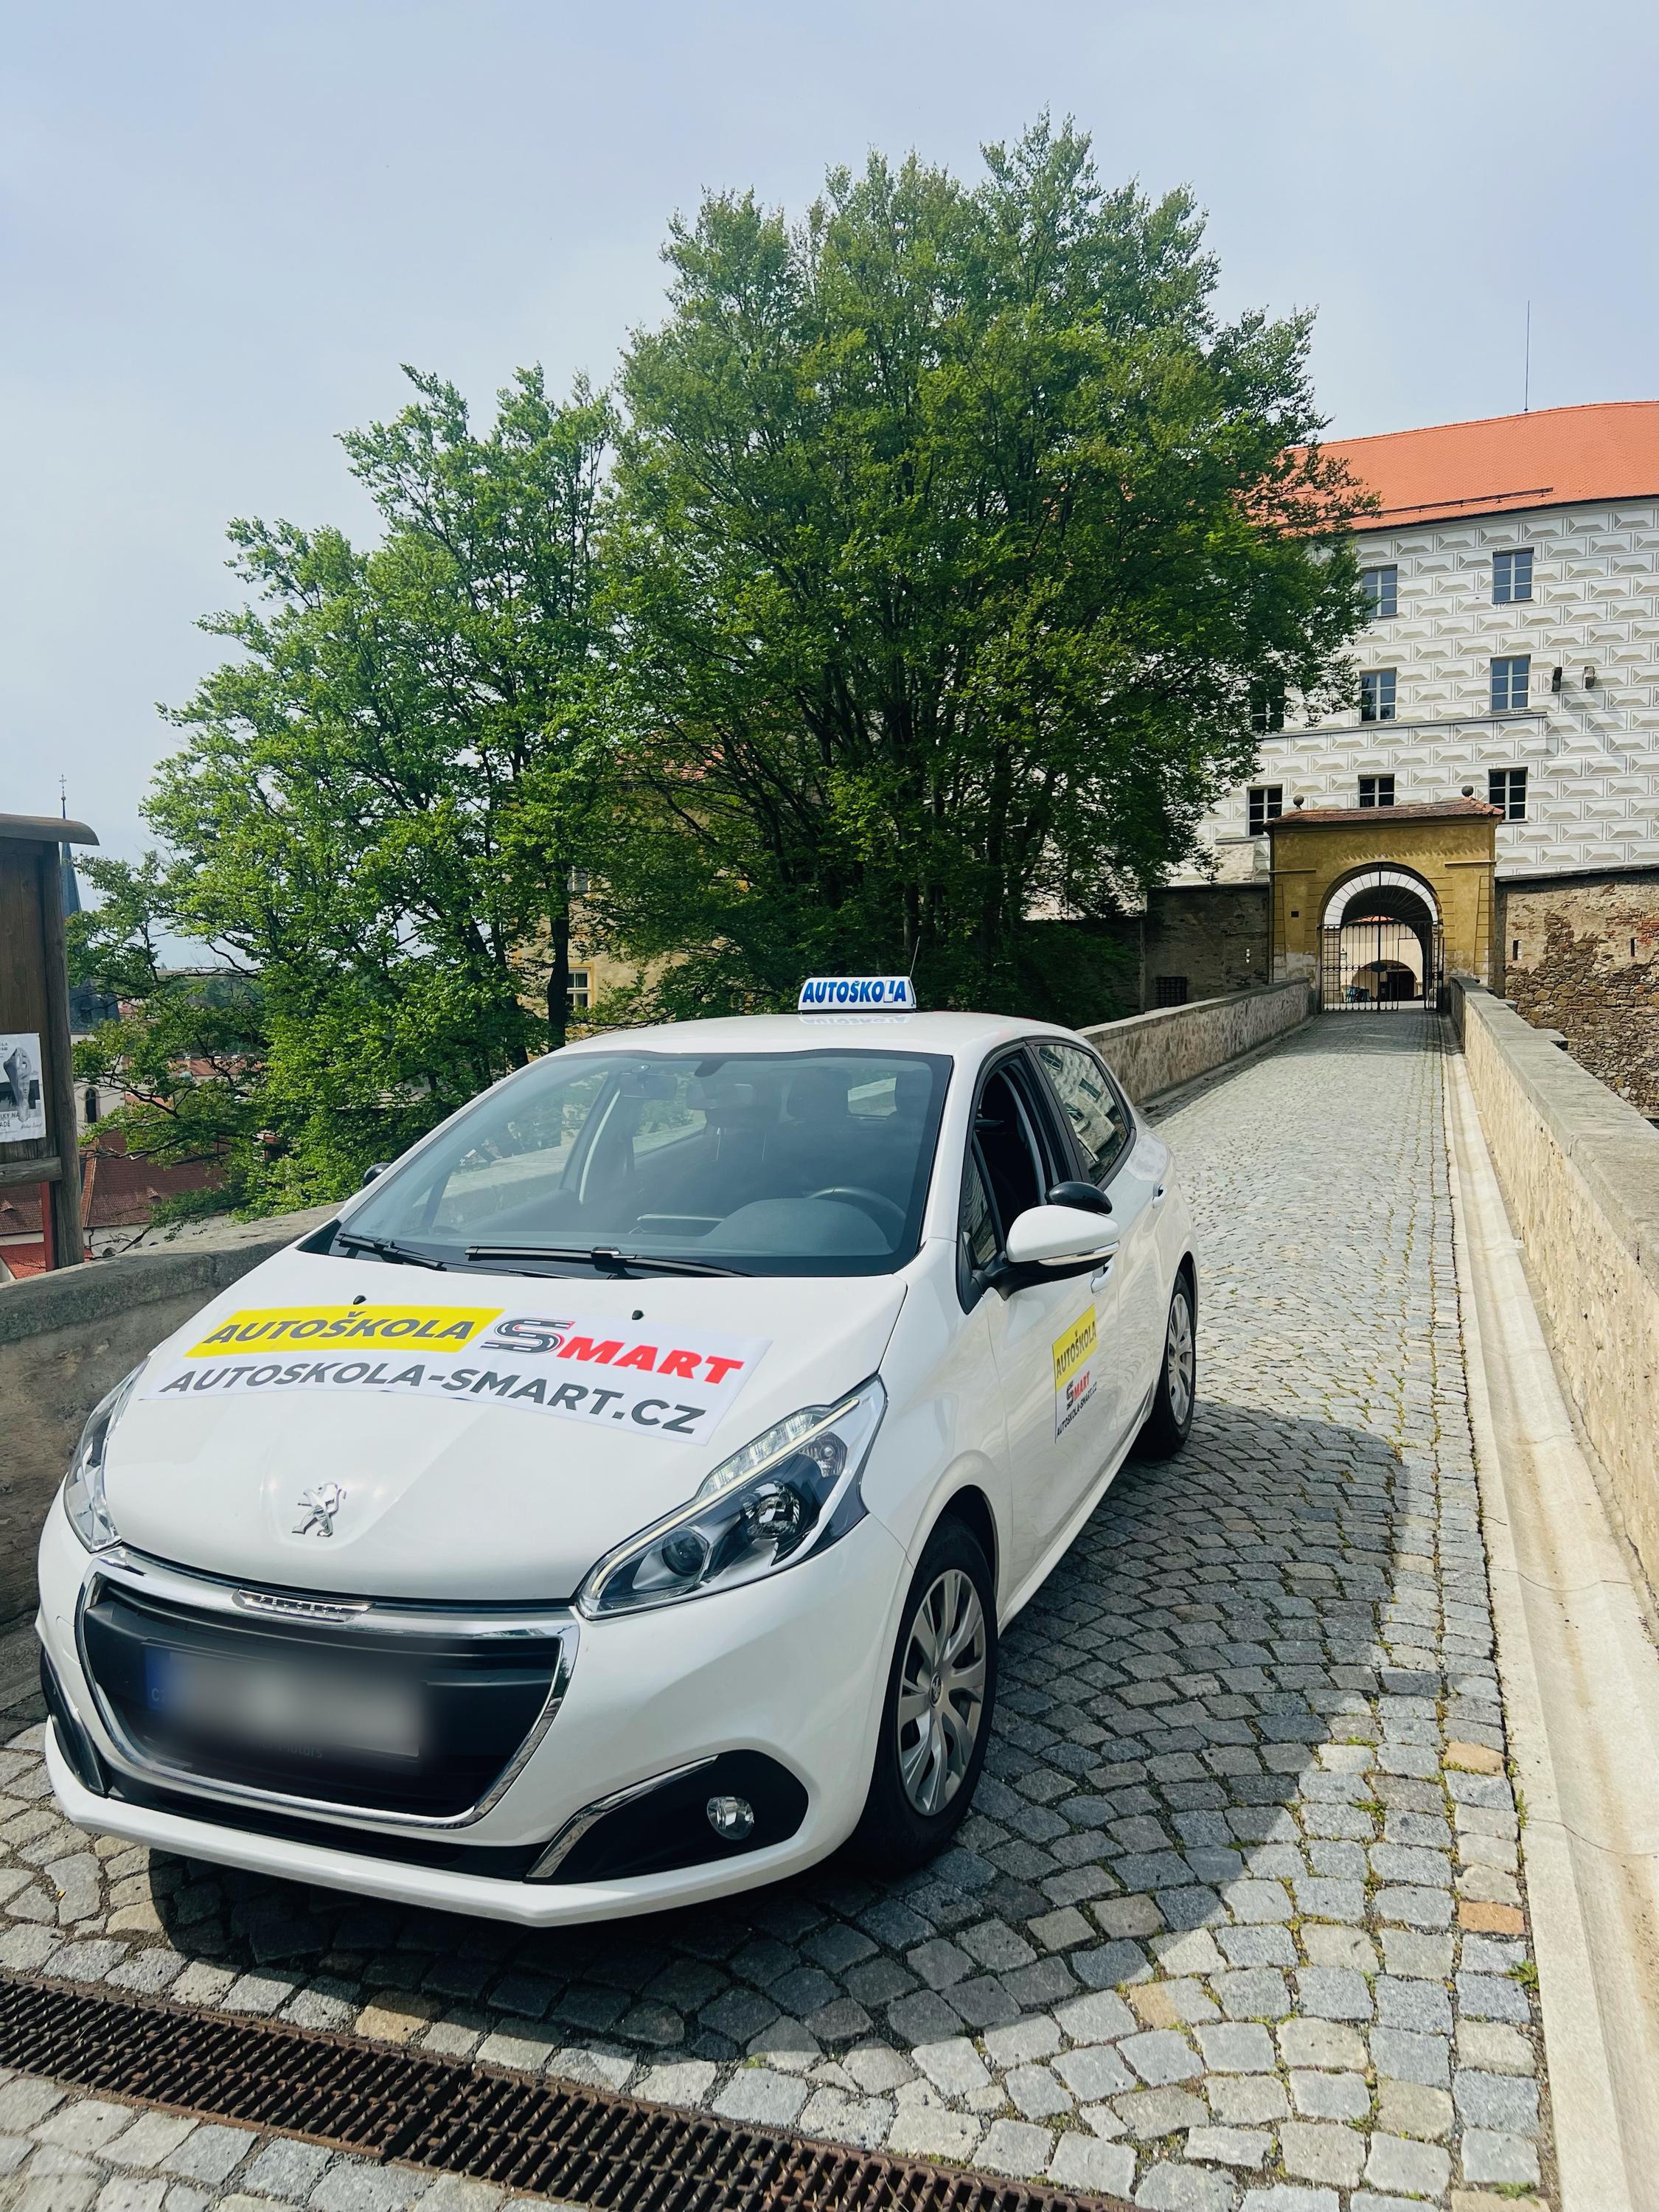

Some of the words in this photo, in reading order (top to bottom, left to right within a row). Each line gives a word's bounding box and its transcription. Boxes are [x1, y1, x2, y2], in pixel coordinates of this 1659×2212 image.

[202, 1311, 473, 1344] AUTOŠKOLA
[479, 1317, 745, 1384] SMART
[1057, 1321, 1096, 1378] AUTOŠKOLA
[159, 1362, 706, 1433] AUTOSKOLA-SMART.CZ
[1066, 1371, 1091, 1410] SMART
